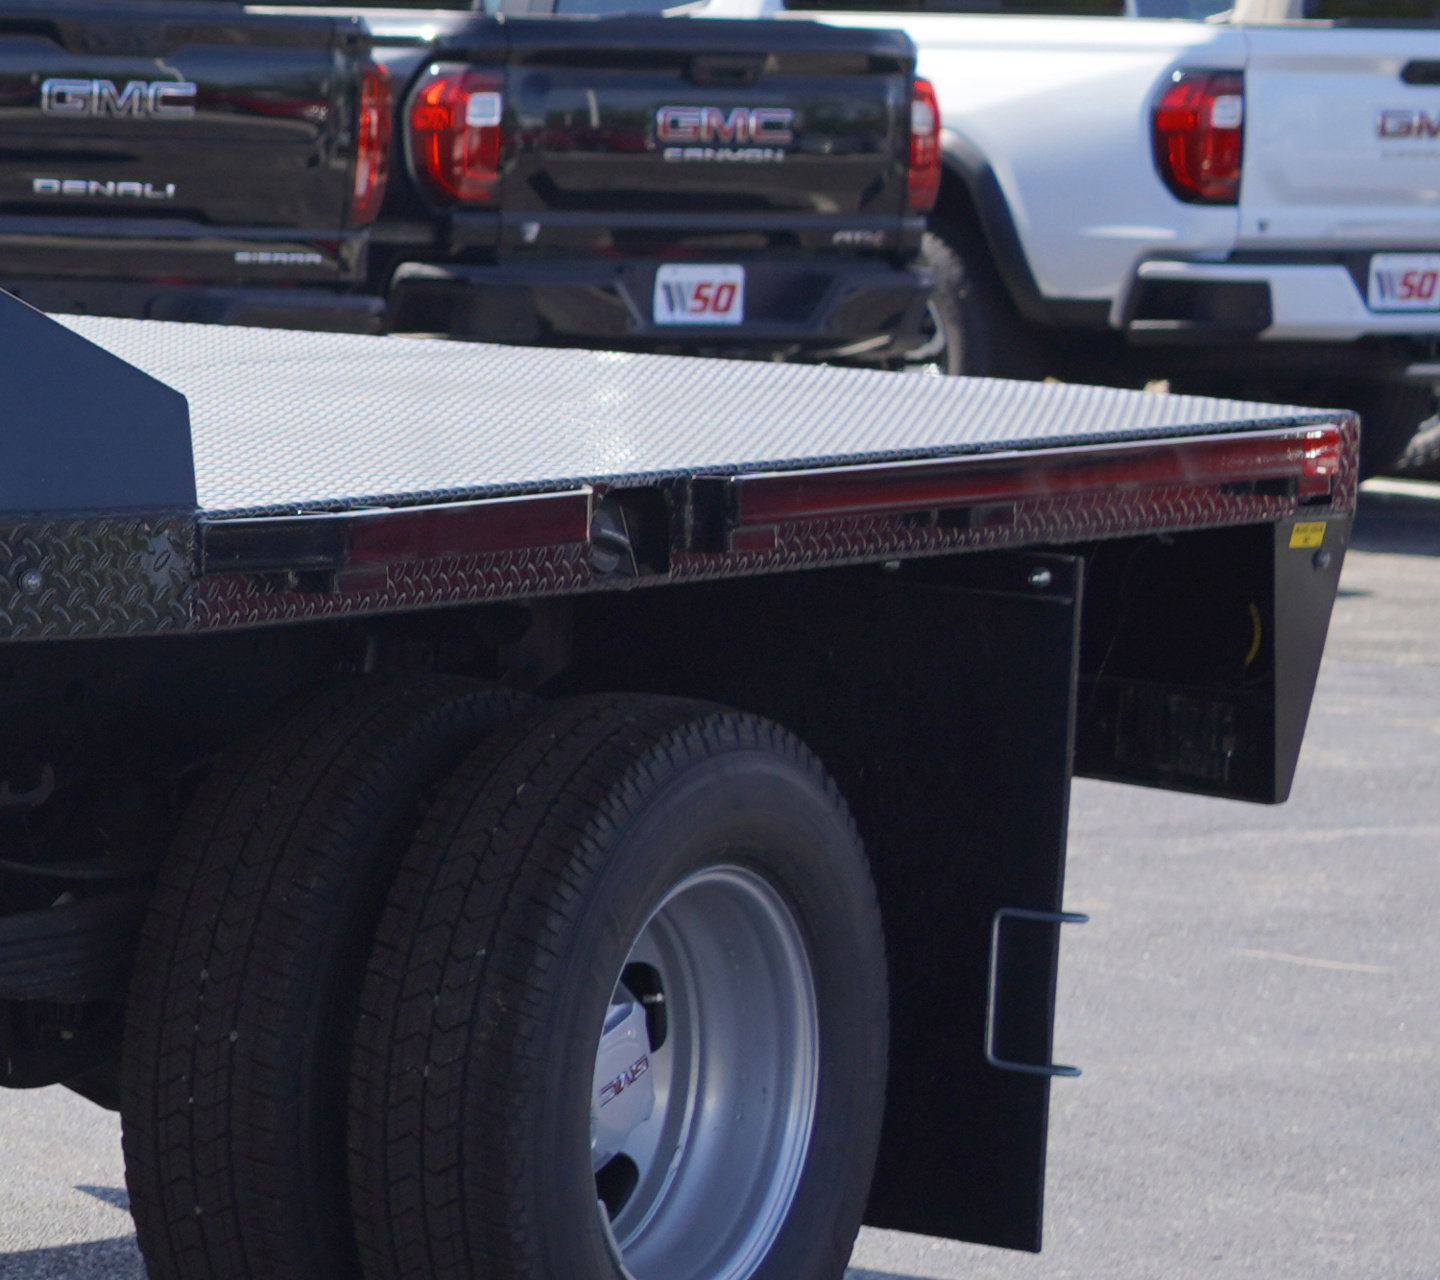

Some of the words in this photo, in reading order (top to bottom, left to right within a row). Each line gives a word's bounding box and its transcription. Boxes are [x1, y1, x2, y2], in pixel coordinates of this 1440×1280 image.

[41, 78, 198, 118] GMC
[656, 106, 794, 143] GMC
[32, 177, 177, 200] DENALI
[234, 250, 323, 265] SIERRA
[599, 1053, 649, 1108] GMC
